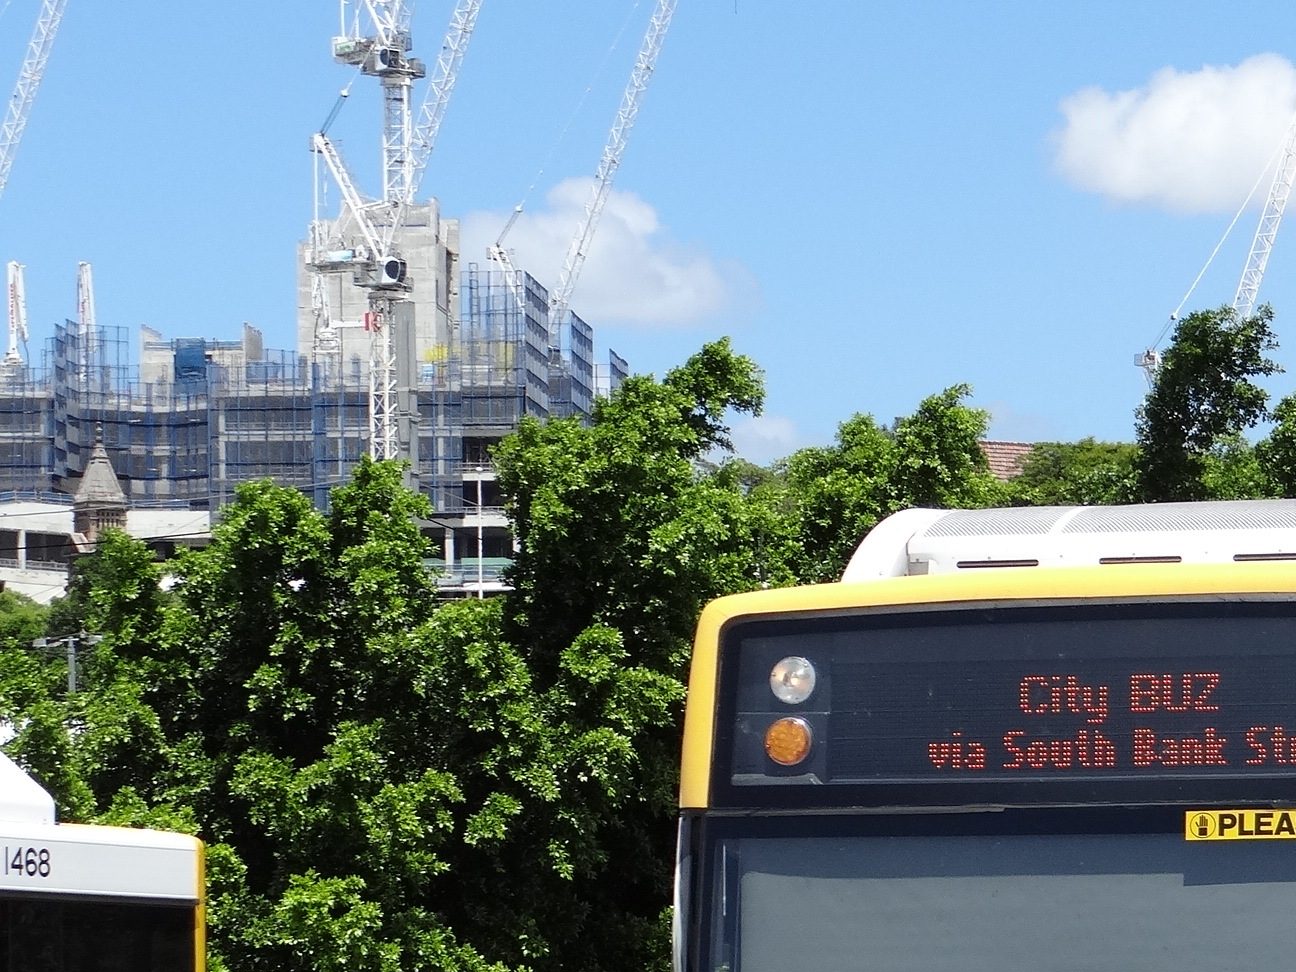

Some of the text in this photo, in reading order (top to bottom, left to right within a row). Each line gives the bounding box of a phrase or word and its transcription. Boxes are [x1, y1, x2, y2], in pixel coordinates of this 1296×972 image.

[1020, 672, 1221, 723] City BUZ
[927, 731, 985, 768] via
[1002, 730, 1115, 768] South
[1133, 727, 1228, 766] Bank
[5, 846, 51, 877] 1468
